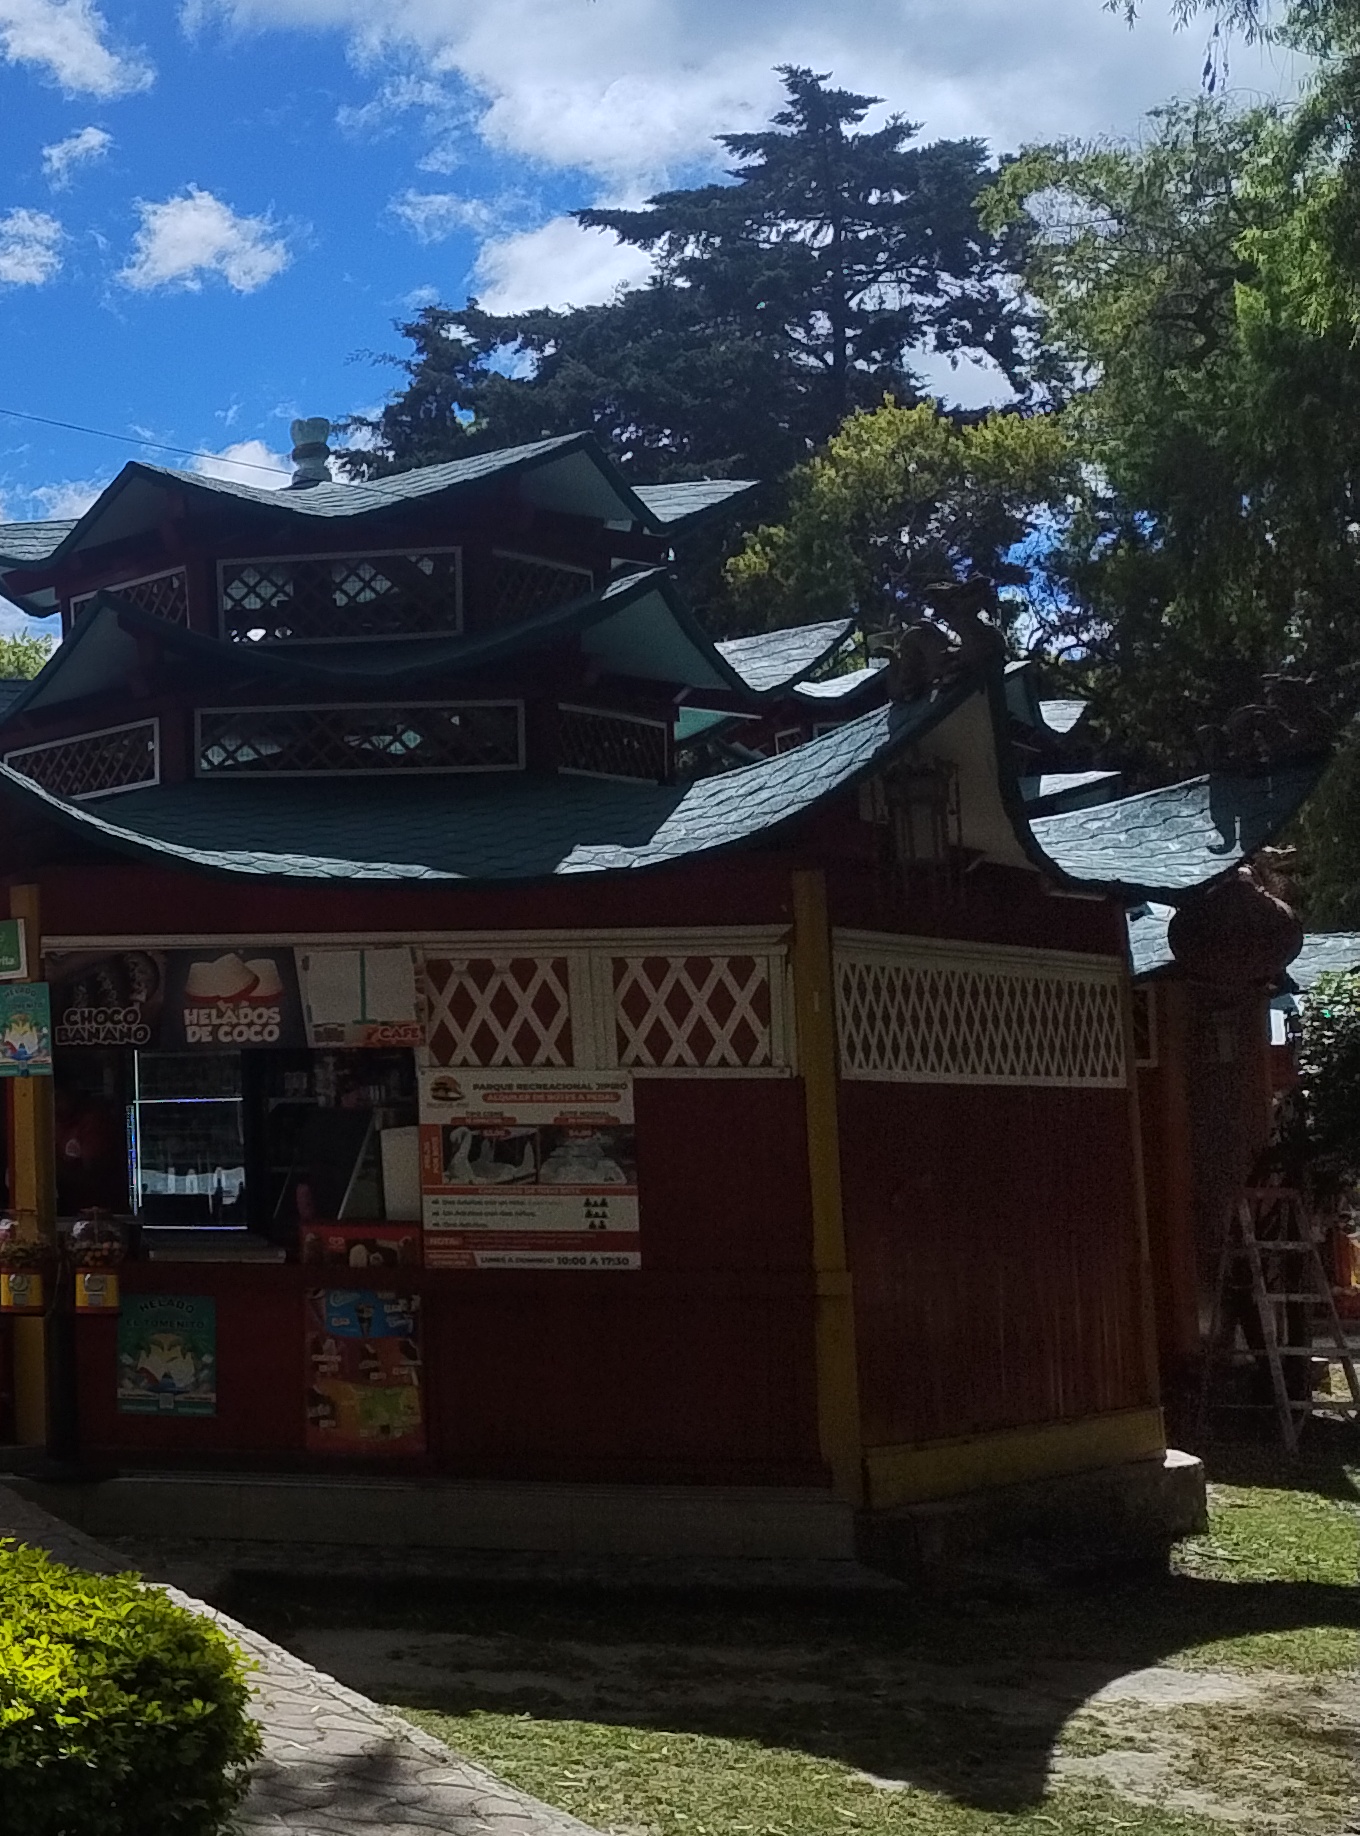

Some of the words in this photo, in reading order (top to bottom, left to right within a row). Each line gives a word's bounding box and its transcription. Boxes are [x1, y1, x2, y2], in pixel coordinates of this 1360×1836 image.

[62, 1006, 141, 1025] CHOCO
[183, 1007, 280, 1025] HELADOS
[55, 1023, 151, 1045] BANANO
[186, 1025, 213, 1044] DE
[218, 1025, 281, 1043] COCO
[557, 1257, 587, 1265] 10:00
[590, 1257, 598, 1265] A
[600, 1256, 630, 1265] 17:30
[140, 1299, 194, 1313] HELADO
